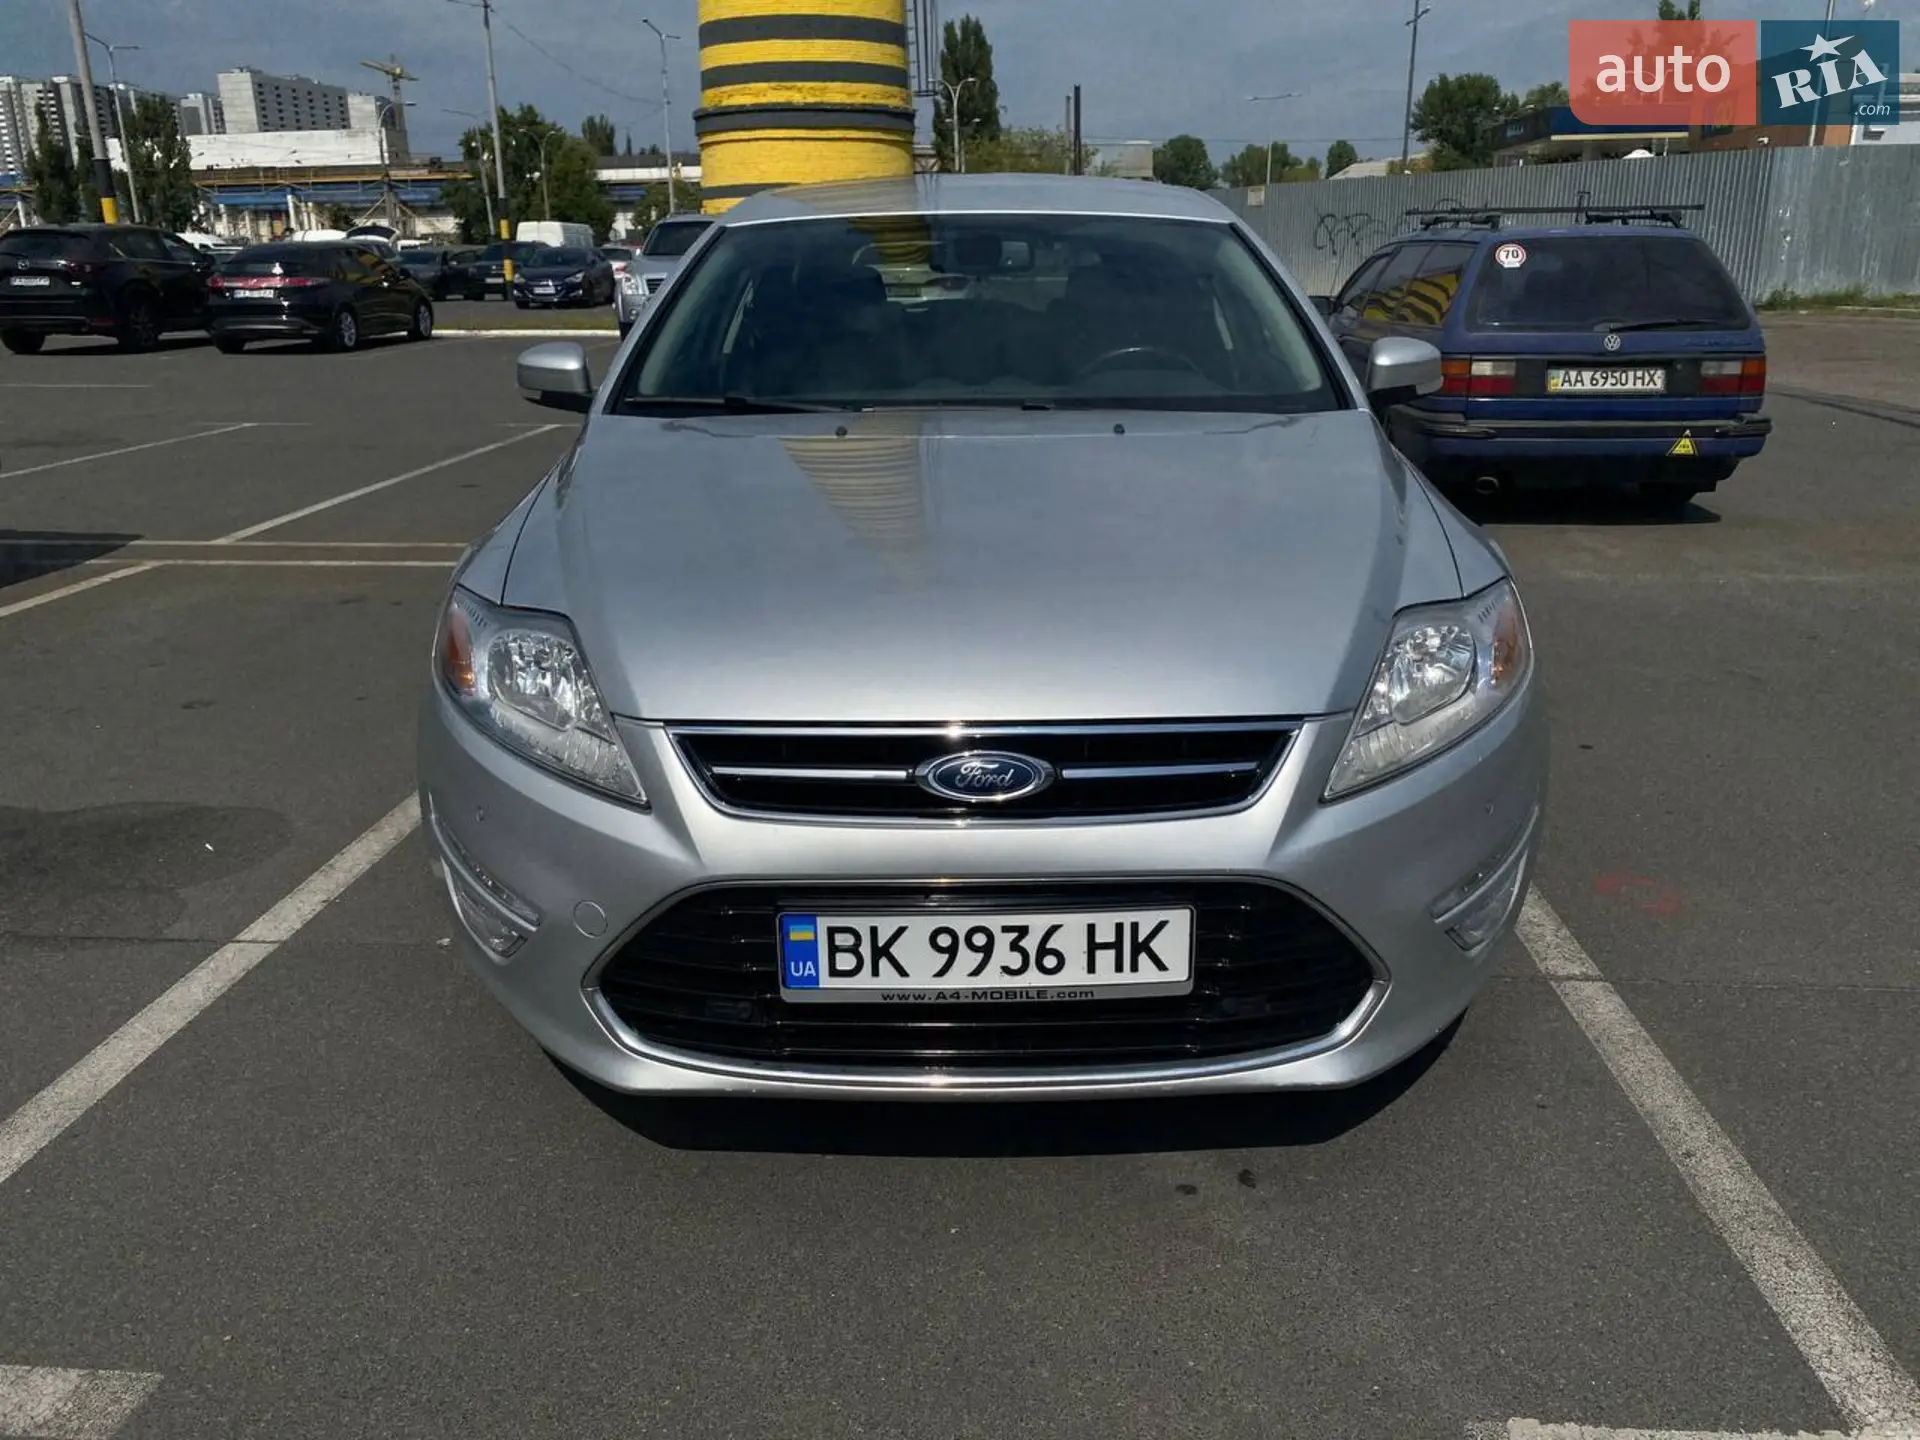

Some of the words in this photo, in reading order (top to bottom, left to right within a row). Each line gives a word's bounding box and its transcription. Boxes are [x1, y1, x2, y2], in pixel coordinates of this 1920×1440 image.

[1502, 249, 1519, 260] 70
[1561, 369, 1585, 388] AA
[1589, 369, 1629, 388] 6950
[1633, 368, 1658, 387] HX
[955, 761, 1015, 789] Ford
[826, 924, 911, 979] BK
[928, 922, 1066, 979] 9936
[1085, 918, 1171, 975] HK
[790, 960, 817, 978] UA
[881, 988, 1095, 1002] www.A4-MOBILE.com
